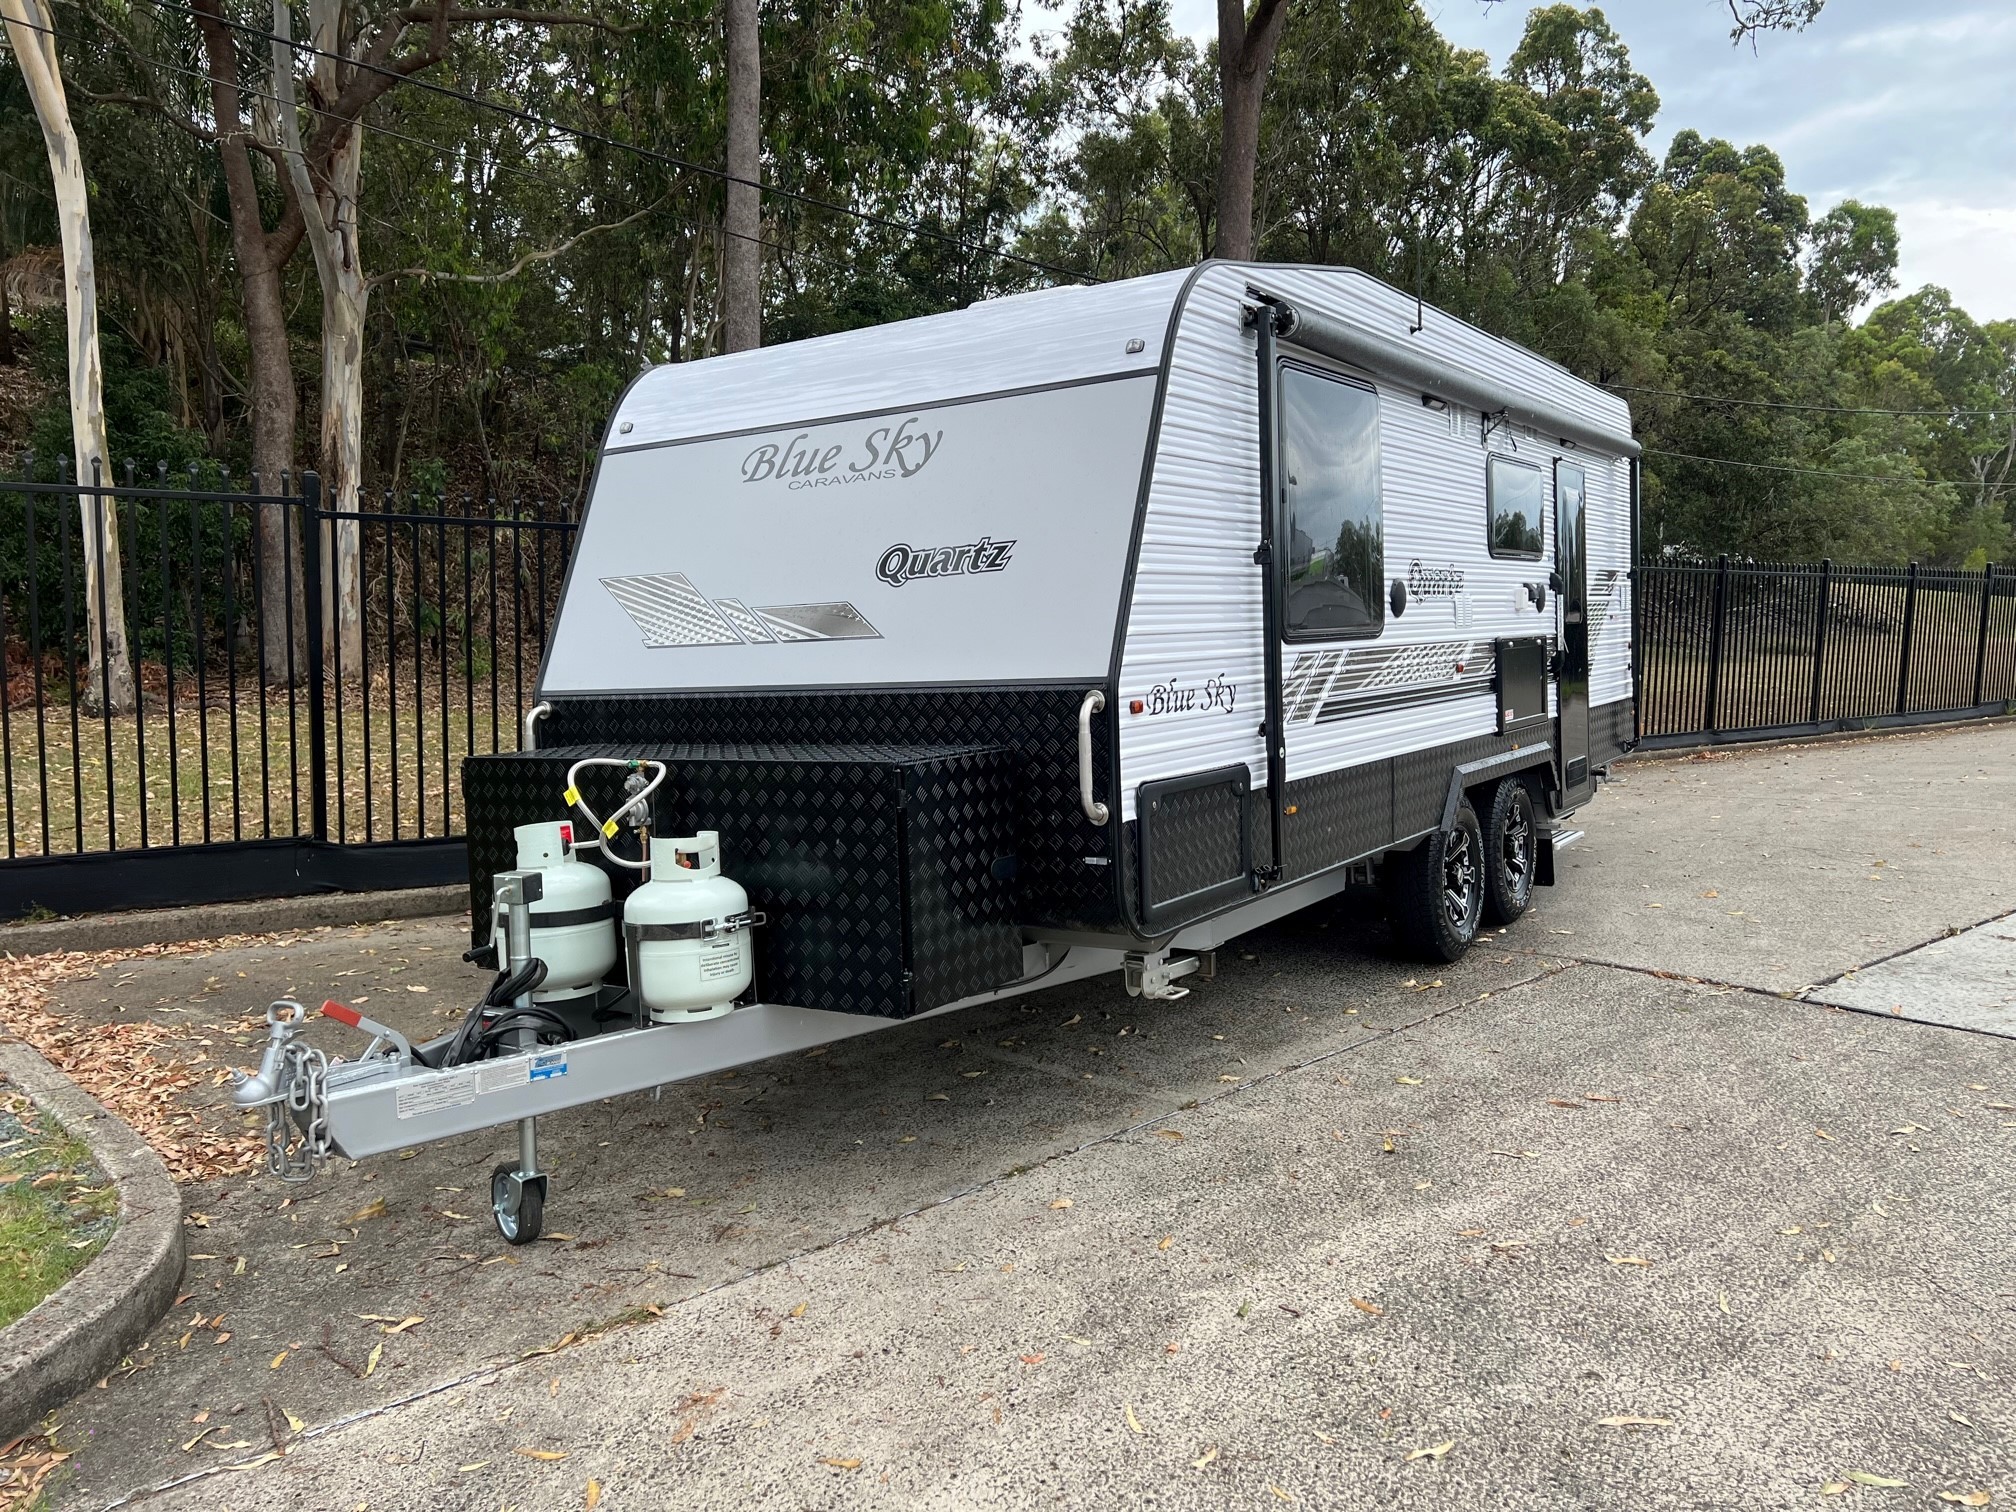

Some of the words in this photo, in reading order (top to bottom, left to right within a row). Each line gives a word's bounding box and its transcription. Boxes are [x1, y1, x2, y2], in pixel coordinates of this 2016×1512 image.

[742, 433, 842, 483] Blue
[849, 417, 943, 478] Sky
[788, 468, 896, 490] CARAVANS
[875, 537, 1017, 587] Quartz
[1146, 678, 1195, 715] Blue
[1200, 673, 1236, 713] Sky
